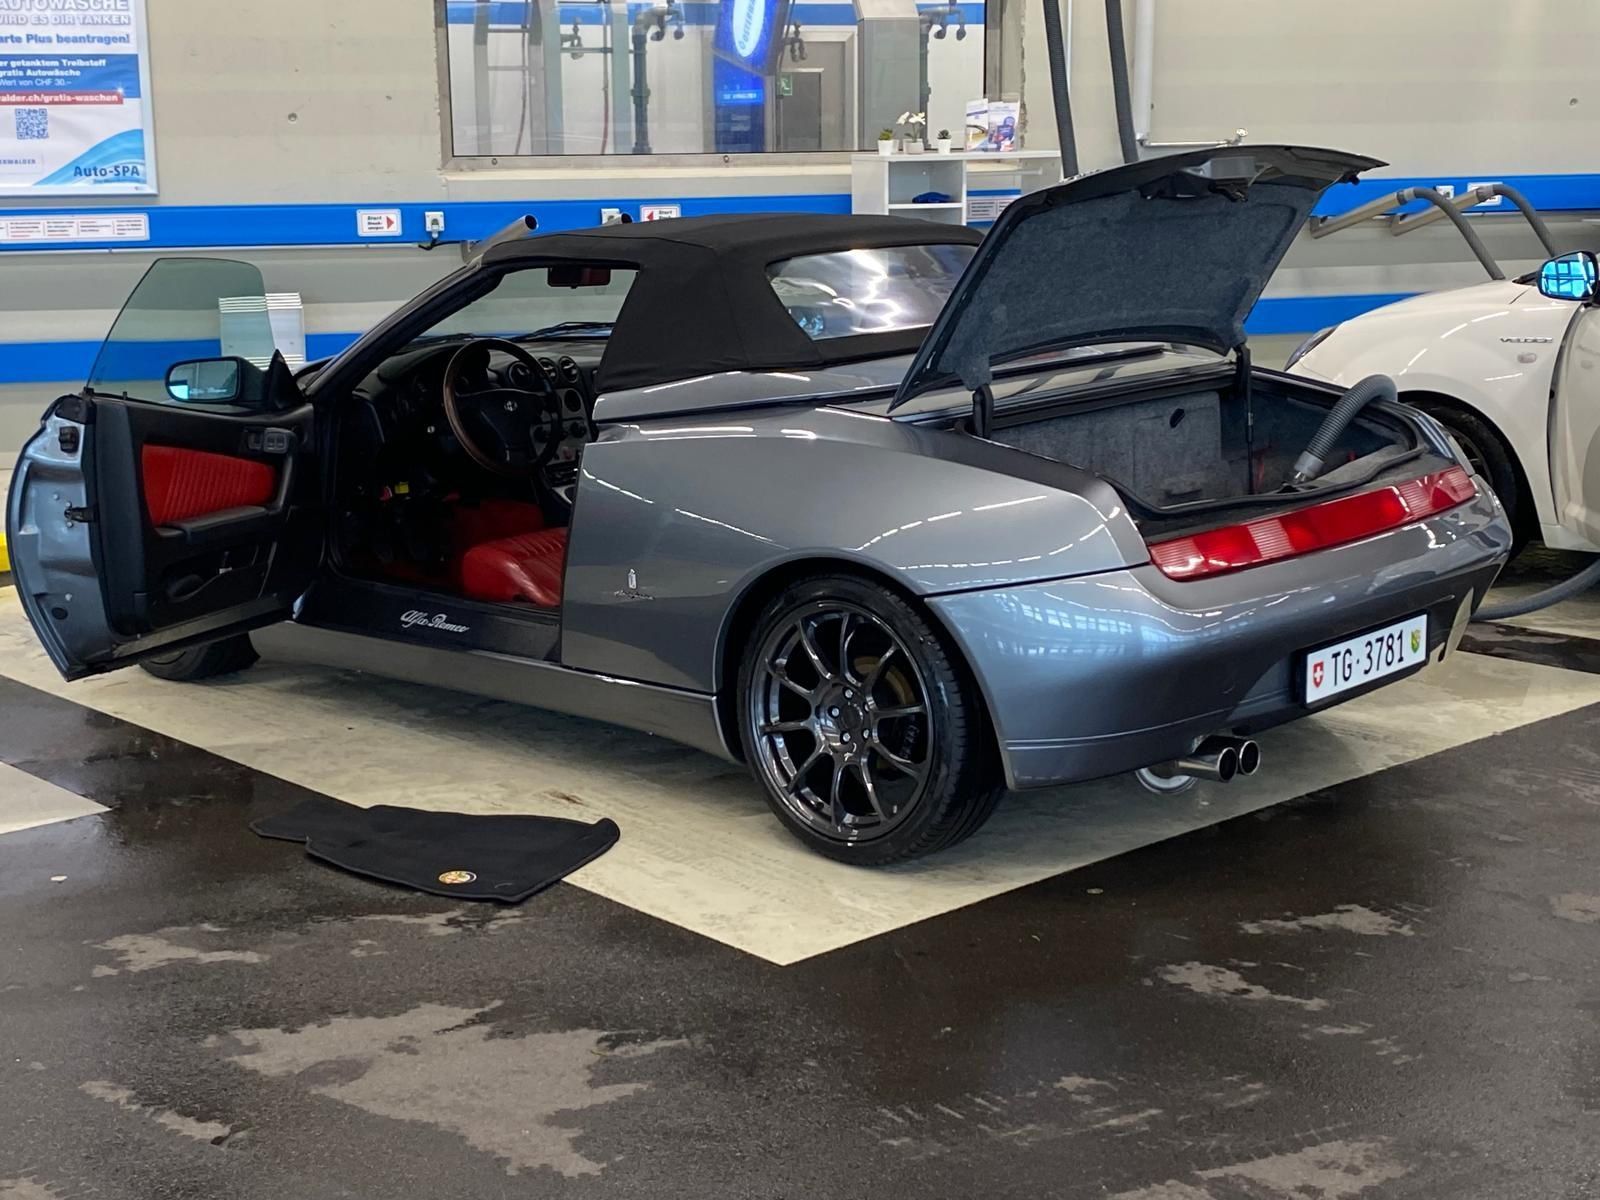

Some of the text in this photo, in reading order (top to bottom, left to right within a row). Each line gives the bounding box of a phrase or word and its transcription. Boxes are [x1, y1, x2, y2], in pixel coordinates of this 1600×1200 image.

[31, 14, 49, 25] ES
[51, 14, 75, 25] DIR
[78, 14, 131, 25] TANKEN
[26, 34, 52, 43] Plus
[56, 33, 129, 45] beantragen!
[10, 59, 59, 68] getanktem
[62, 58, 106, 67] Treibstoff
[26, 68, 81, 76] Autowäsche
[34, 78, 53, 86] CHF
[74, 165, 140, 177] Auto-SPA
[400, 609, 470, 633] Alfa Romeo
